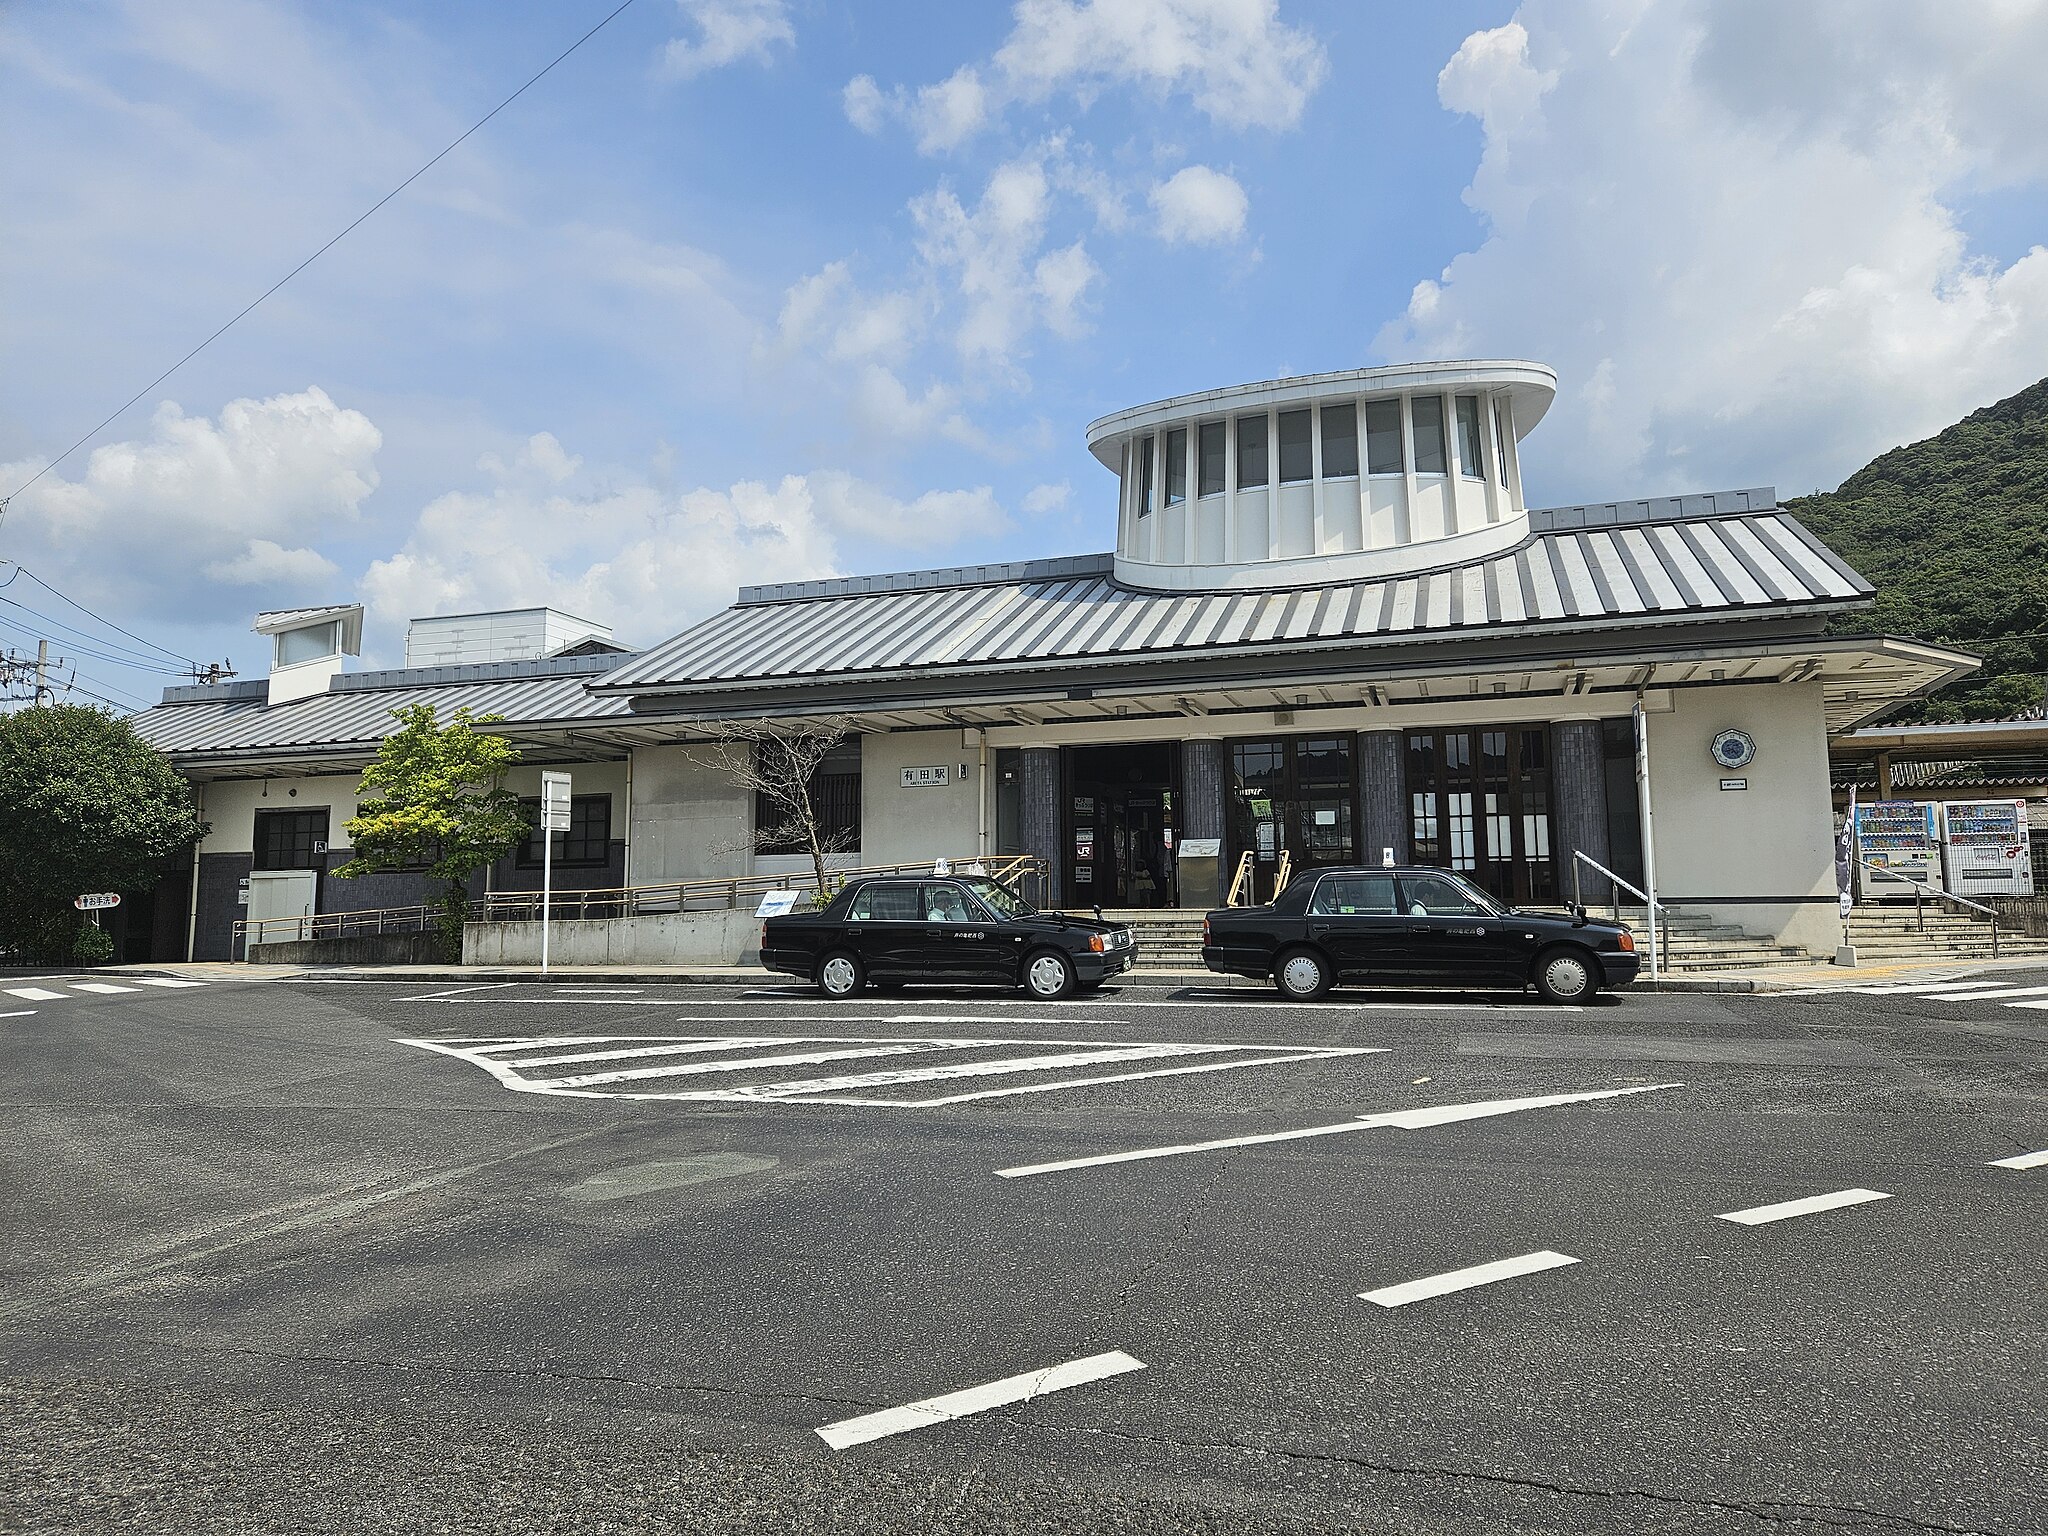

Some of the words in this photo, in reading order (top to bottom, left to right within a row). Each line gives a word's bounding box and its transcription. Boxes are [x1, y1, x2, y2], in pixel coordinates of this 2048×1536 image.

[904, 768, 945, 781] 有田駅
[1078, 846, 1090, 854] JR
[89, 896, 110, 906] お手洗
